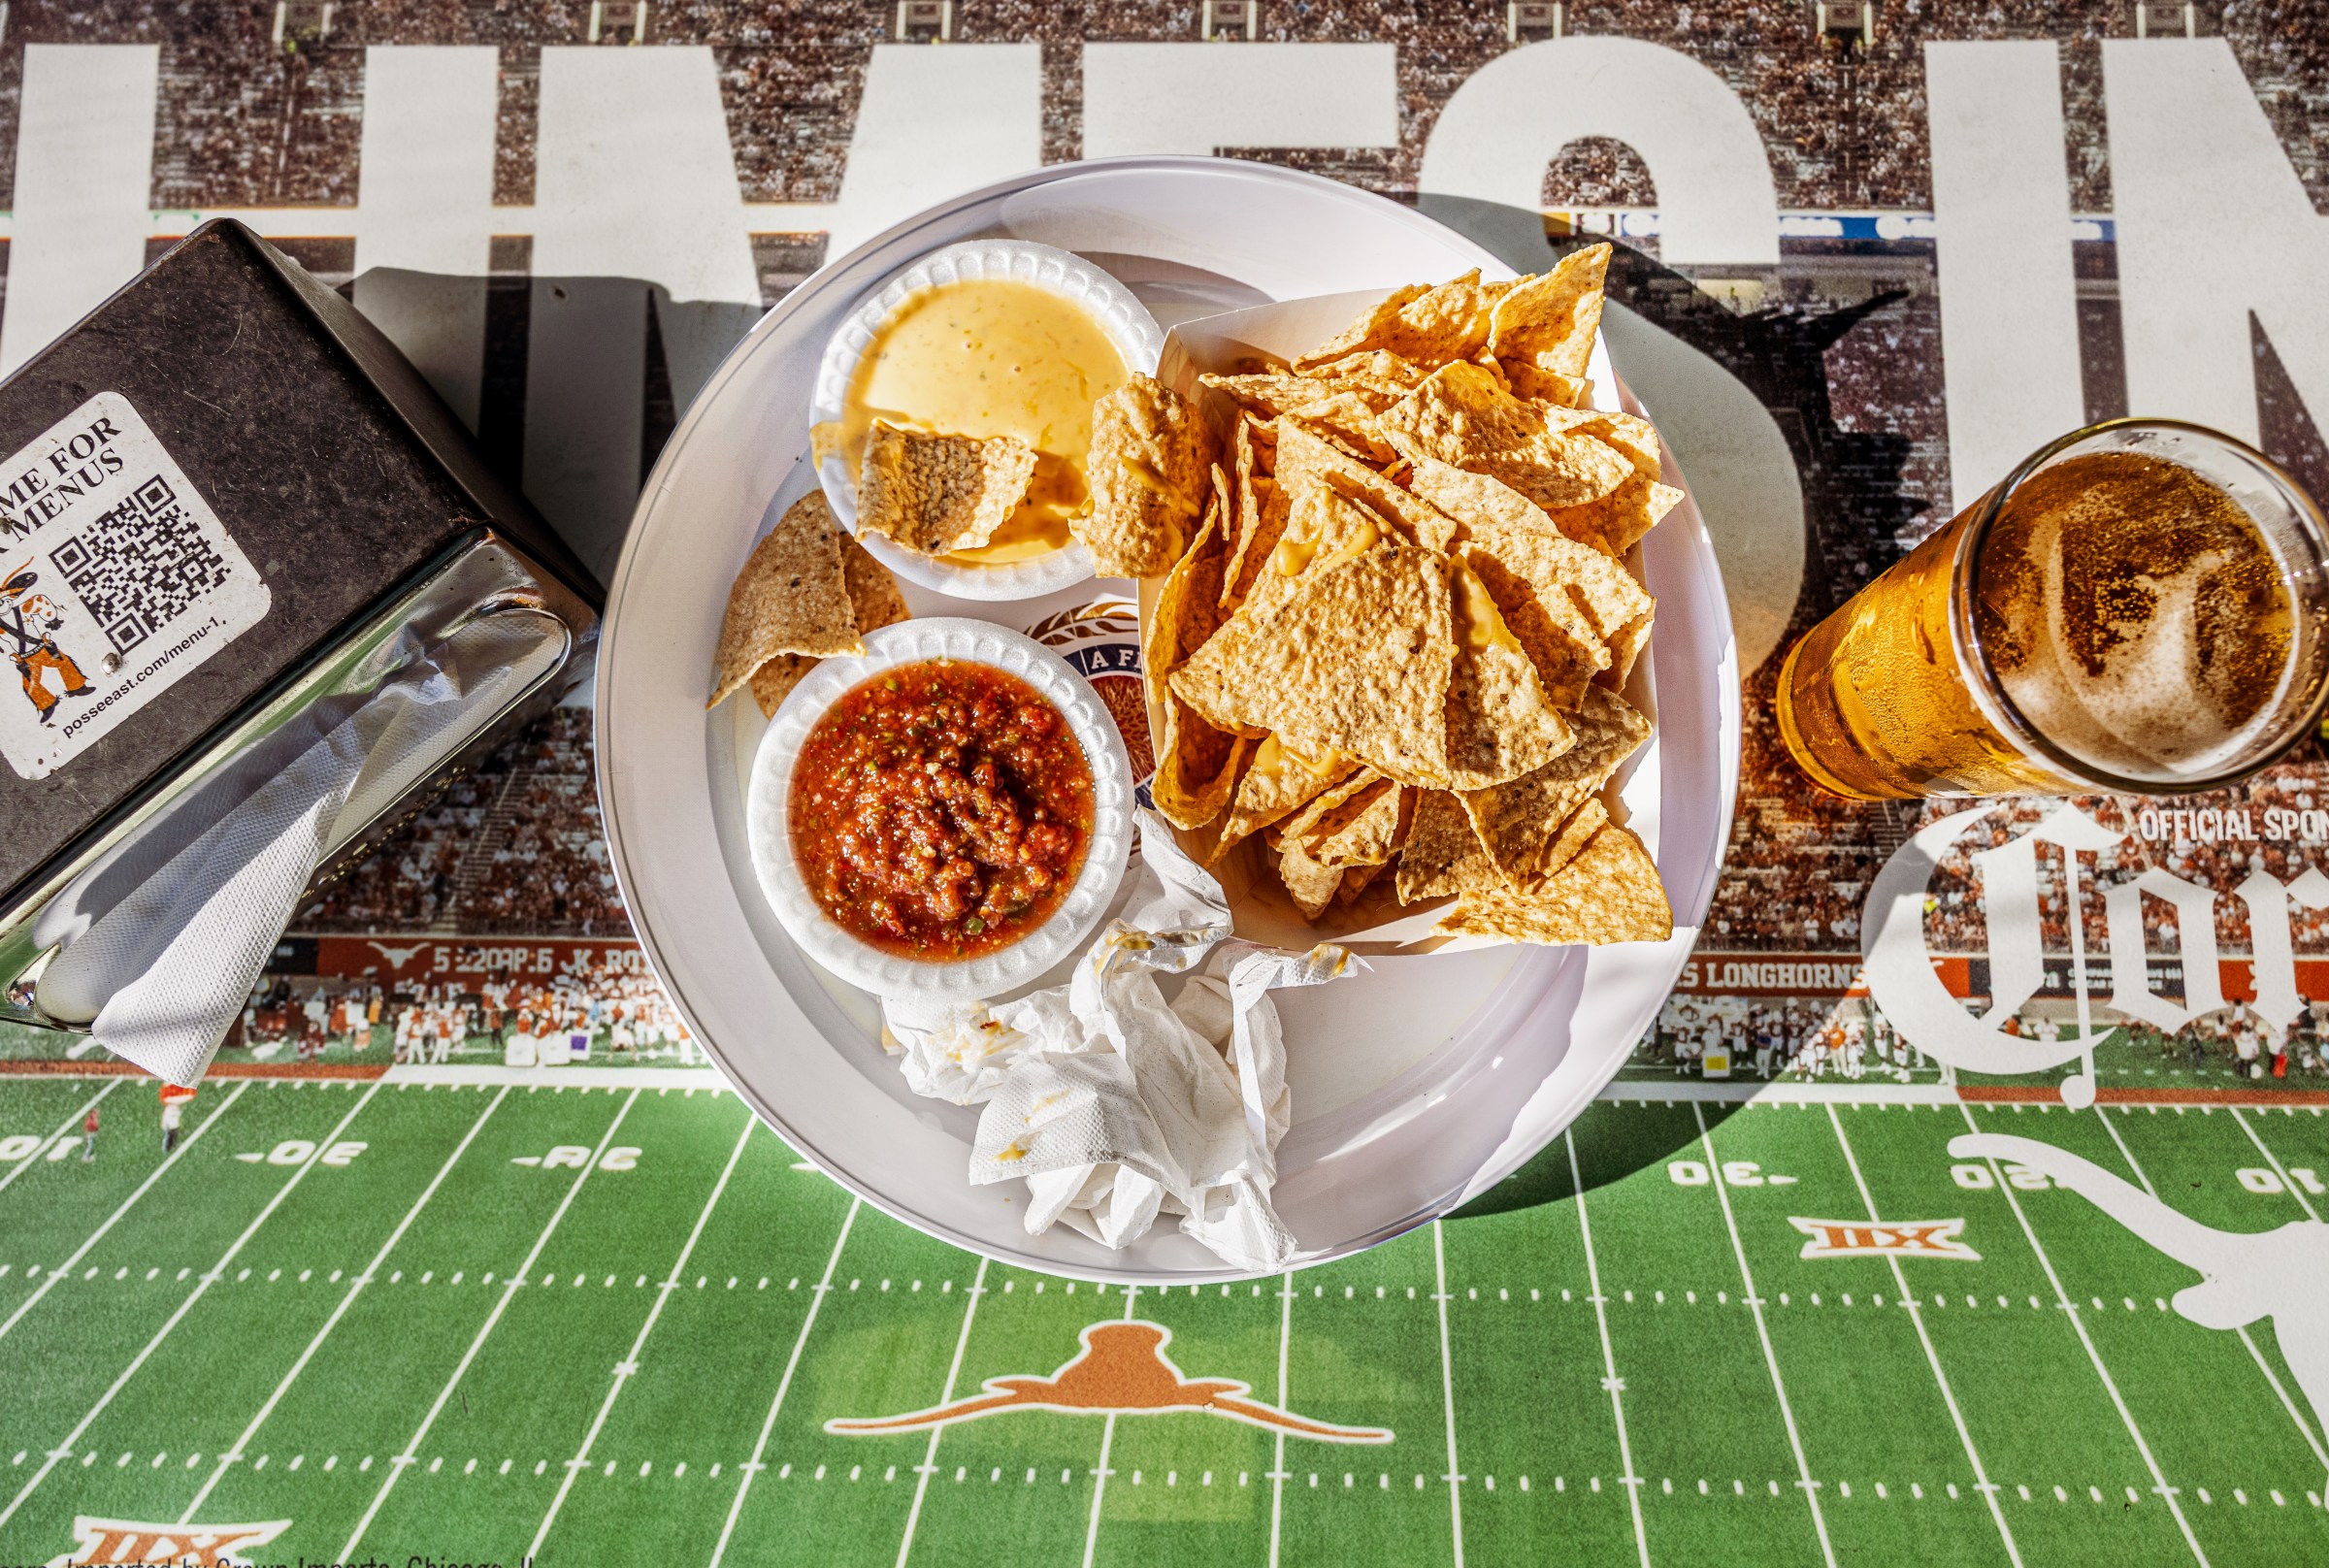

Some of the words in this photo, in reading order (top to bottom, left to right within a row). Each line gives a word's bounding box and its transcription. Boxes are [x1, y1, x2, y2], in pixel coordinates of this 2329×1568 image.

[46, 417, 122, 477] FOR
[10, 447, 123, 543] MENUS
[2139, 809, 2259, 841] OFFICIAL
